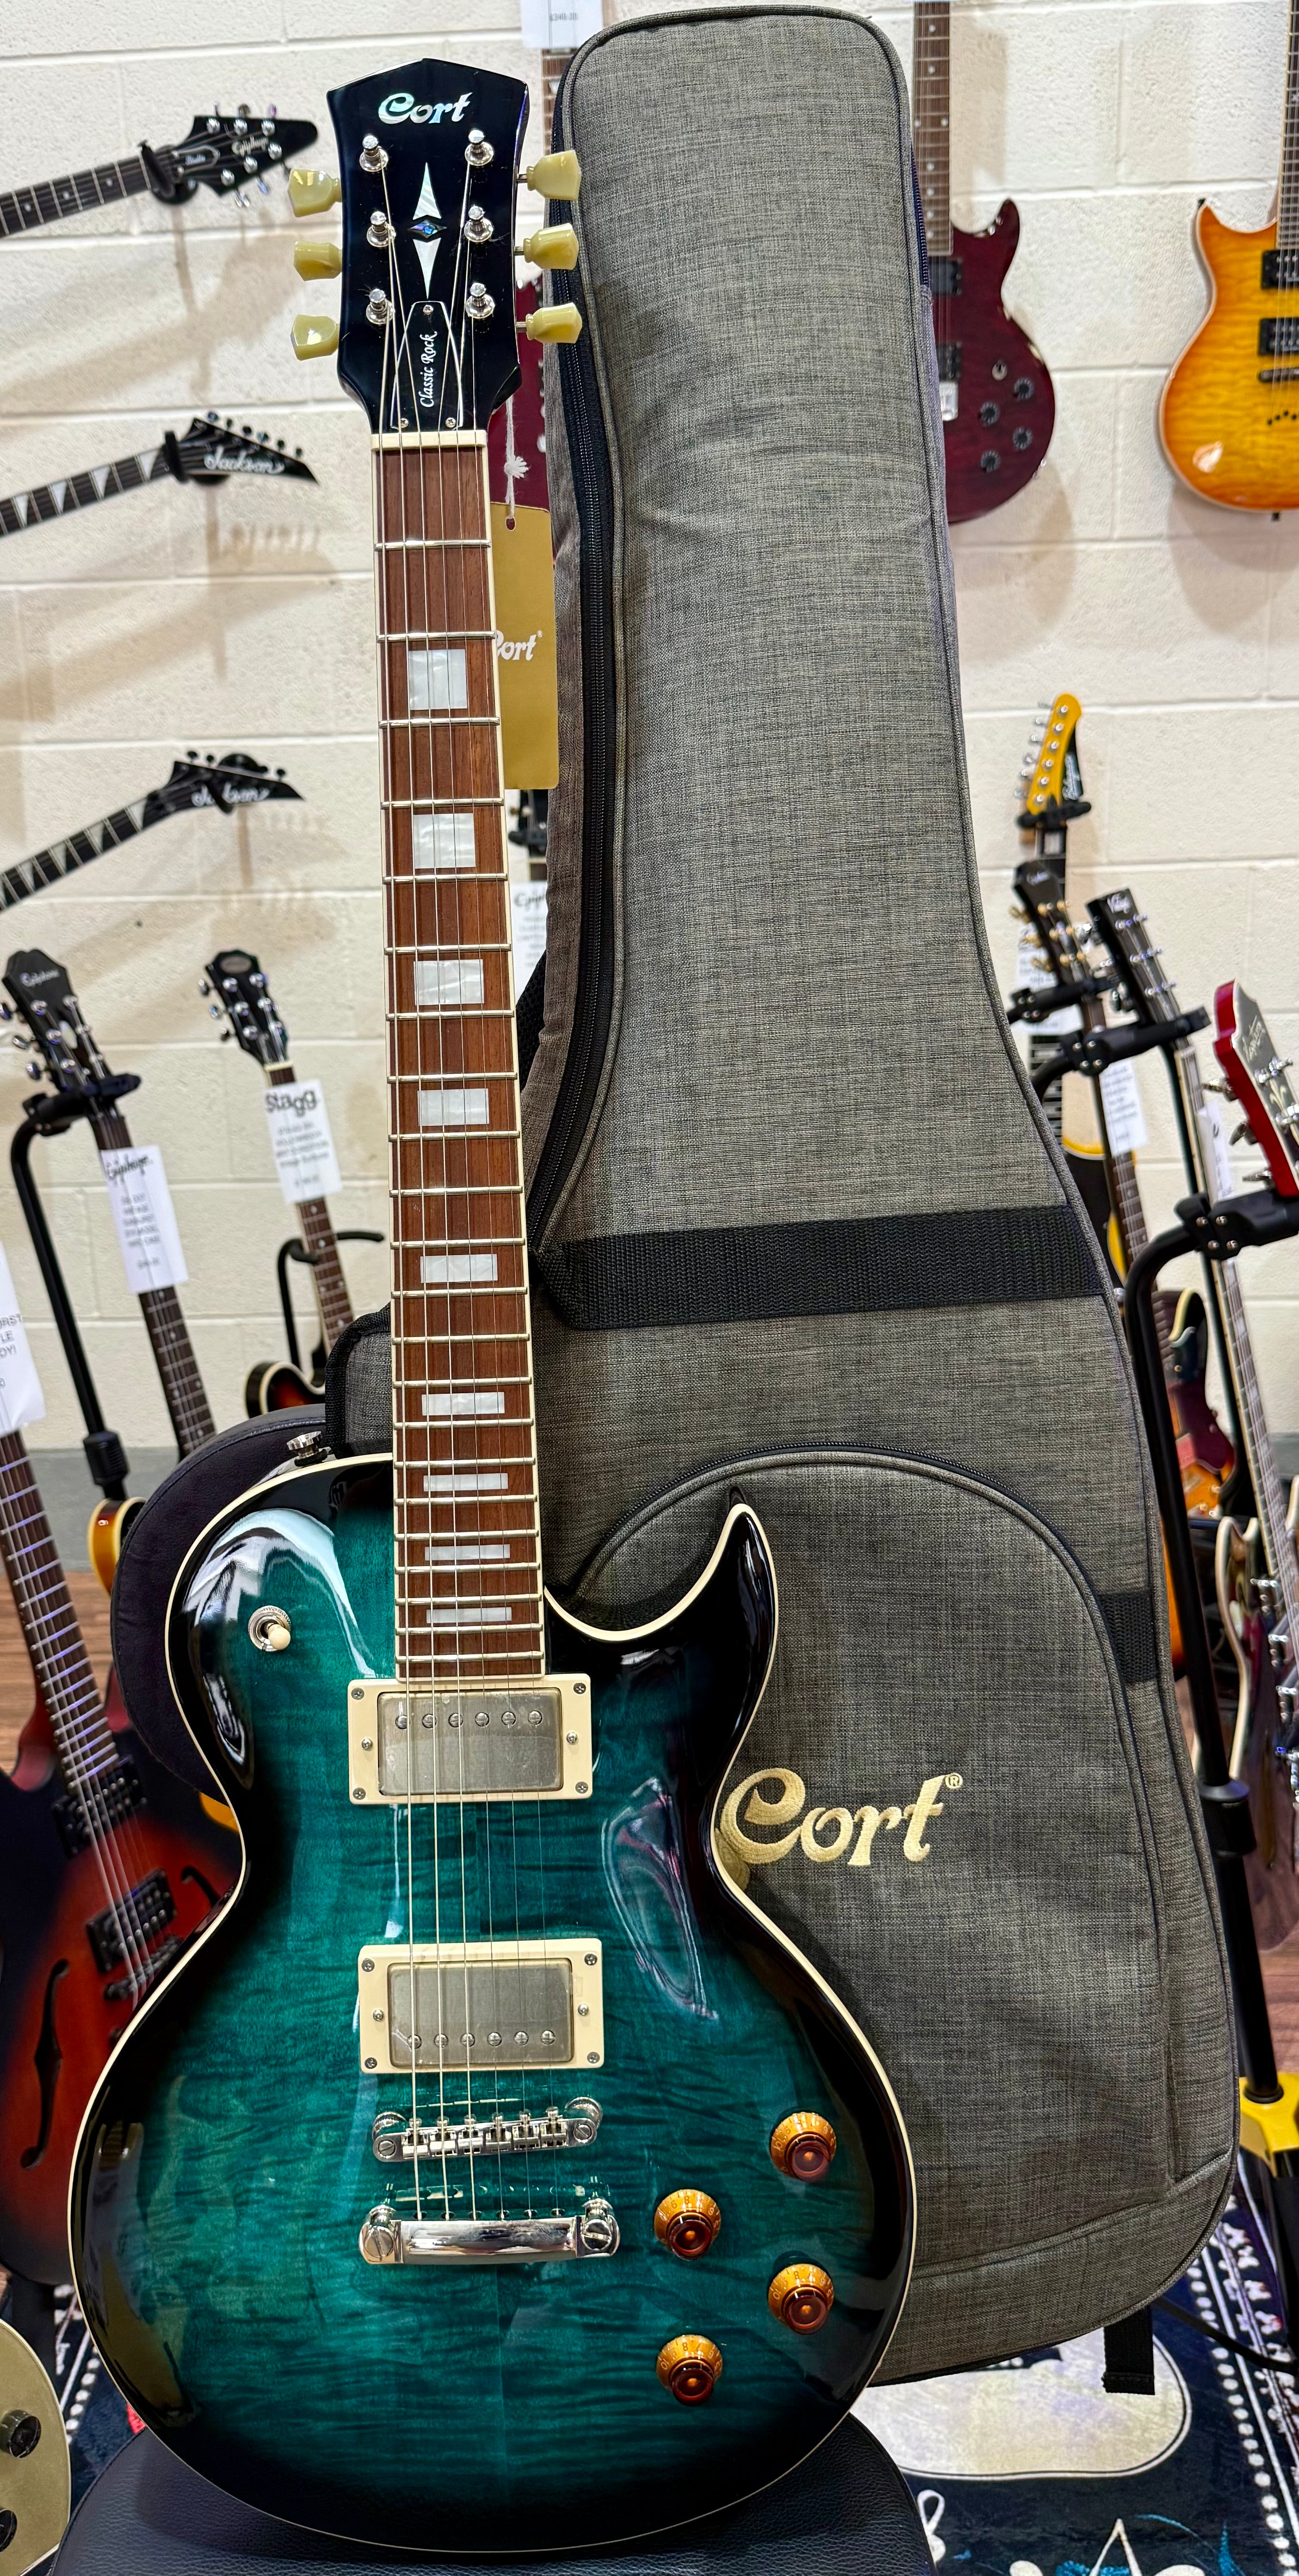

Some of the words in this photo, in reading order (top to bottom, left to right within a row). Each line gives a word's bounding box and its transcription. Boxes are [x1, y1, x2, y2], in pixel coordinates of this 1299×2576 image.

[378, 92, 473, 124] Cort
[419, 331, 438, 364] Rock
[418, 366, 434, 407] Classic
[203, 445, 285, 474] Jackson
